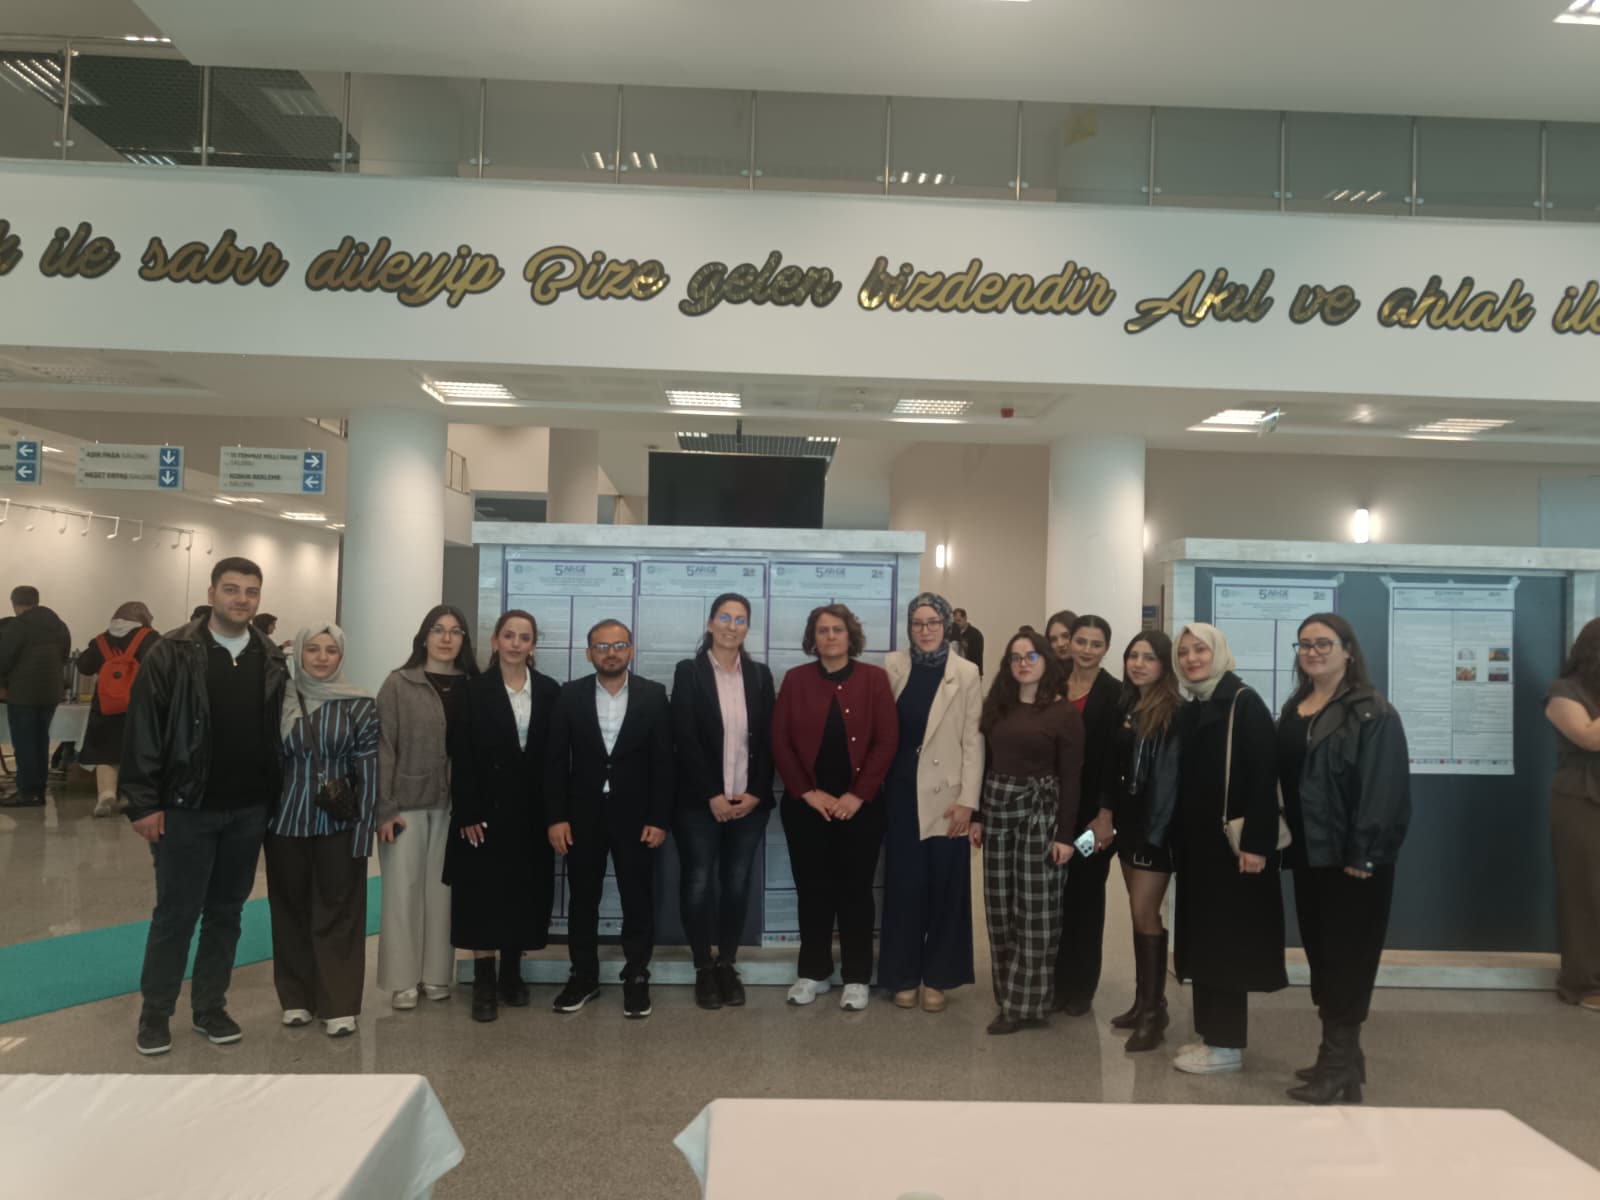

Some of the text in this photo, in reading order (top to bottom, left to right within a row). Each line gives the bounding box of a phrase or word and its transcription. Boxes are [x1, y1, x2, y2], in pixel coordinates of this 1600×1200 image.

[39, 221, 121, 280] ile
[138, 228, 290, 288] sabır
[305, 235, 506, 309] dileyip
[678, 250, 843, 317] gelen
[858, 256, 1117, 317] bizdendir
[1124, 267, 1275, 335] Akıl
[1289, 284, 1361, 326] ve
[1377, 274, 1536, 333] ahlak
